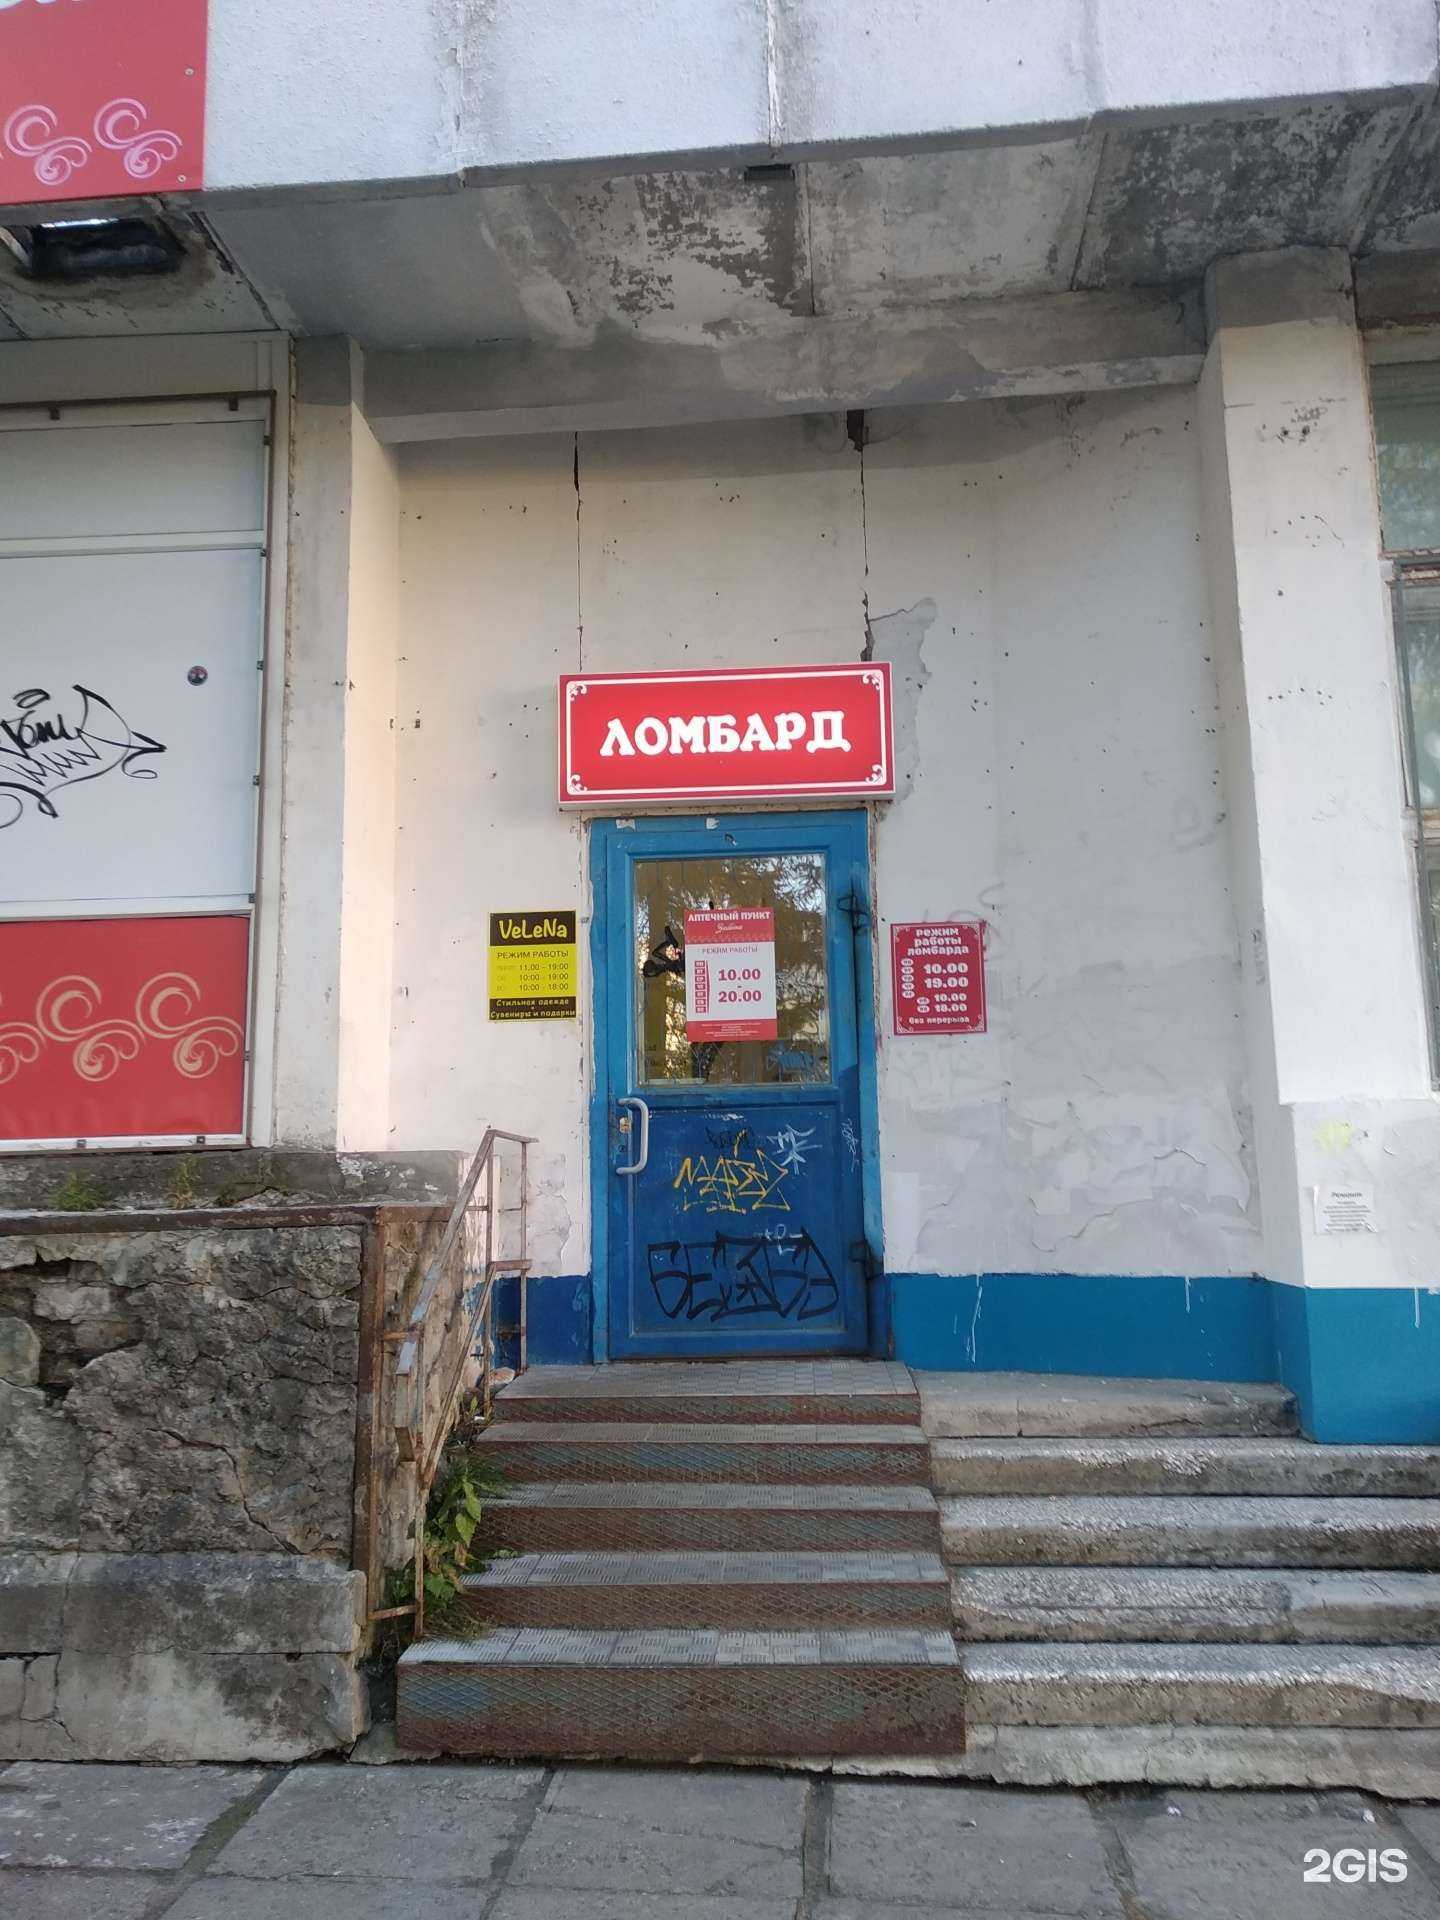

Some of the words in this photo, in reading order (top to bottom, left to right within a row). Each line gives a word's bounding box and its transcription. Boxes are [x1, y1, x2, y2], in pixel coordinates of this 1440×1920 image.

[600, 711, 852, 757] ЛОМБАРД
[688, 911, 739, 922] АПТЕЧНЫЙ
[741, 911, 770, 920] ПУНКТ
[499, 919, 568, 939] VeLeNa
[497, 951, 530, 959] РЕЖИМ
[533, 950, 568, 958] РАБОТЫ
[718, 968, 761, 981] 10.00
[924, 963, 969, 974] 10.00
[925, 977, 969, 989] 19.00
[718, 990, 762, 1003] 20.00
[934, 993, 967, 1003] 10.00
